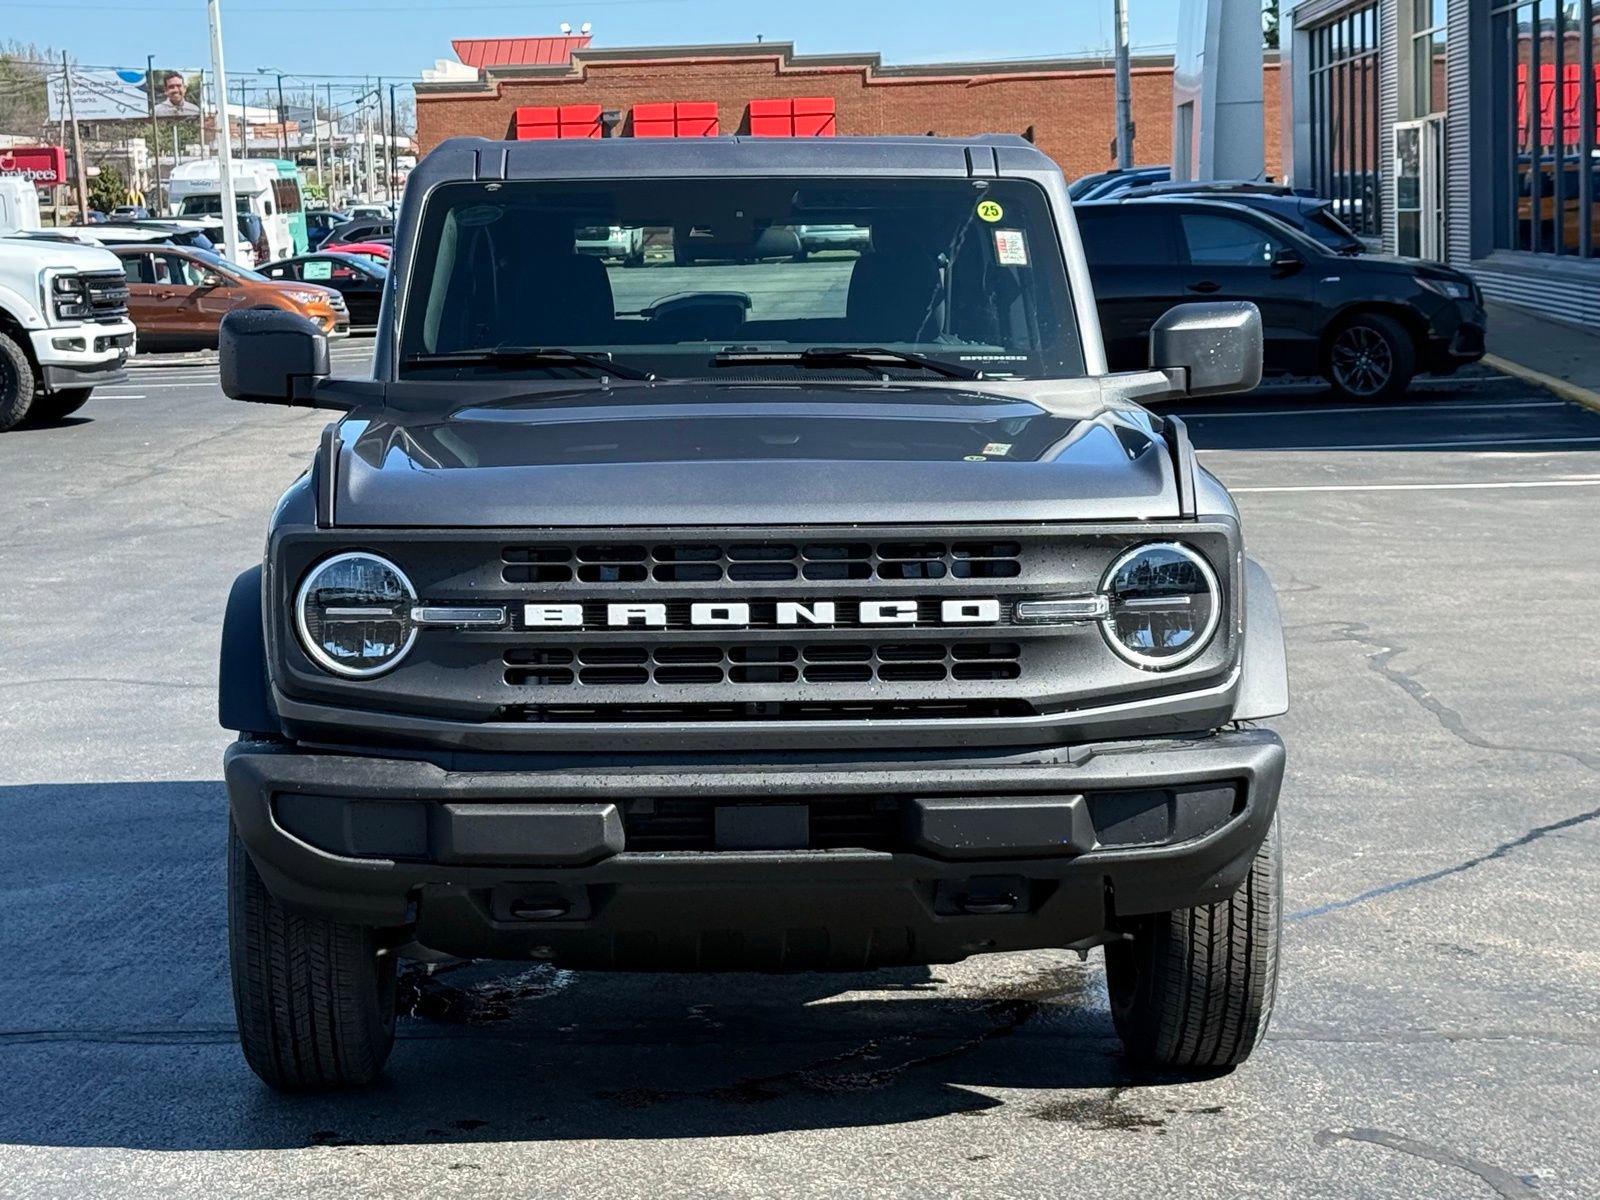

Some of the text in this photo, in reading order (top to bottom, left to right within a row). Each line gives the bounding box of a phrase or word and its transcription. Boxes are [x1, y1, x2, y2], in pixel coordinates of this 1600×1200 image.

[0, 167, 57, 180] pplebee's
[982, 205, 999, 216] 25
[524, 600, 1000, 626] BRONCO
